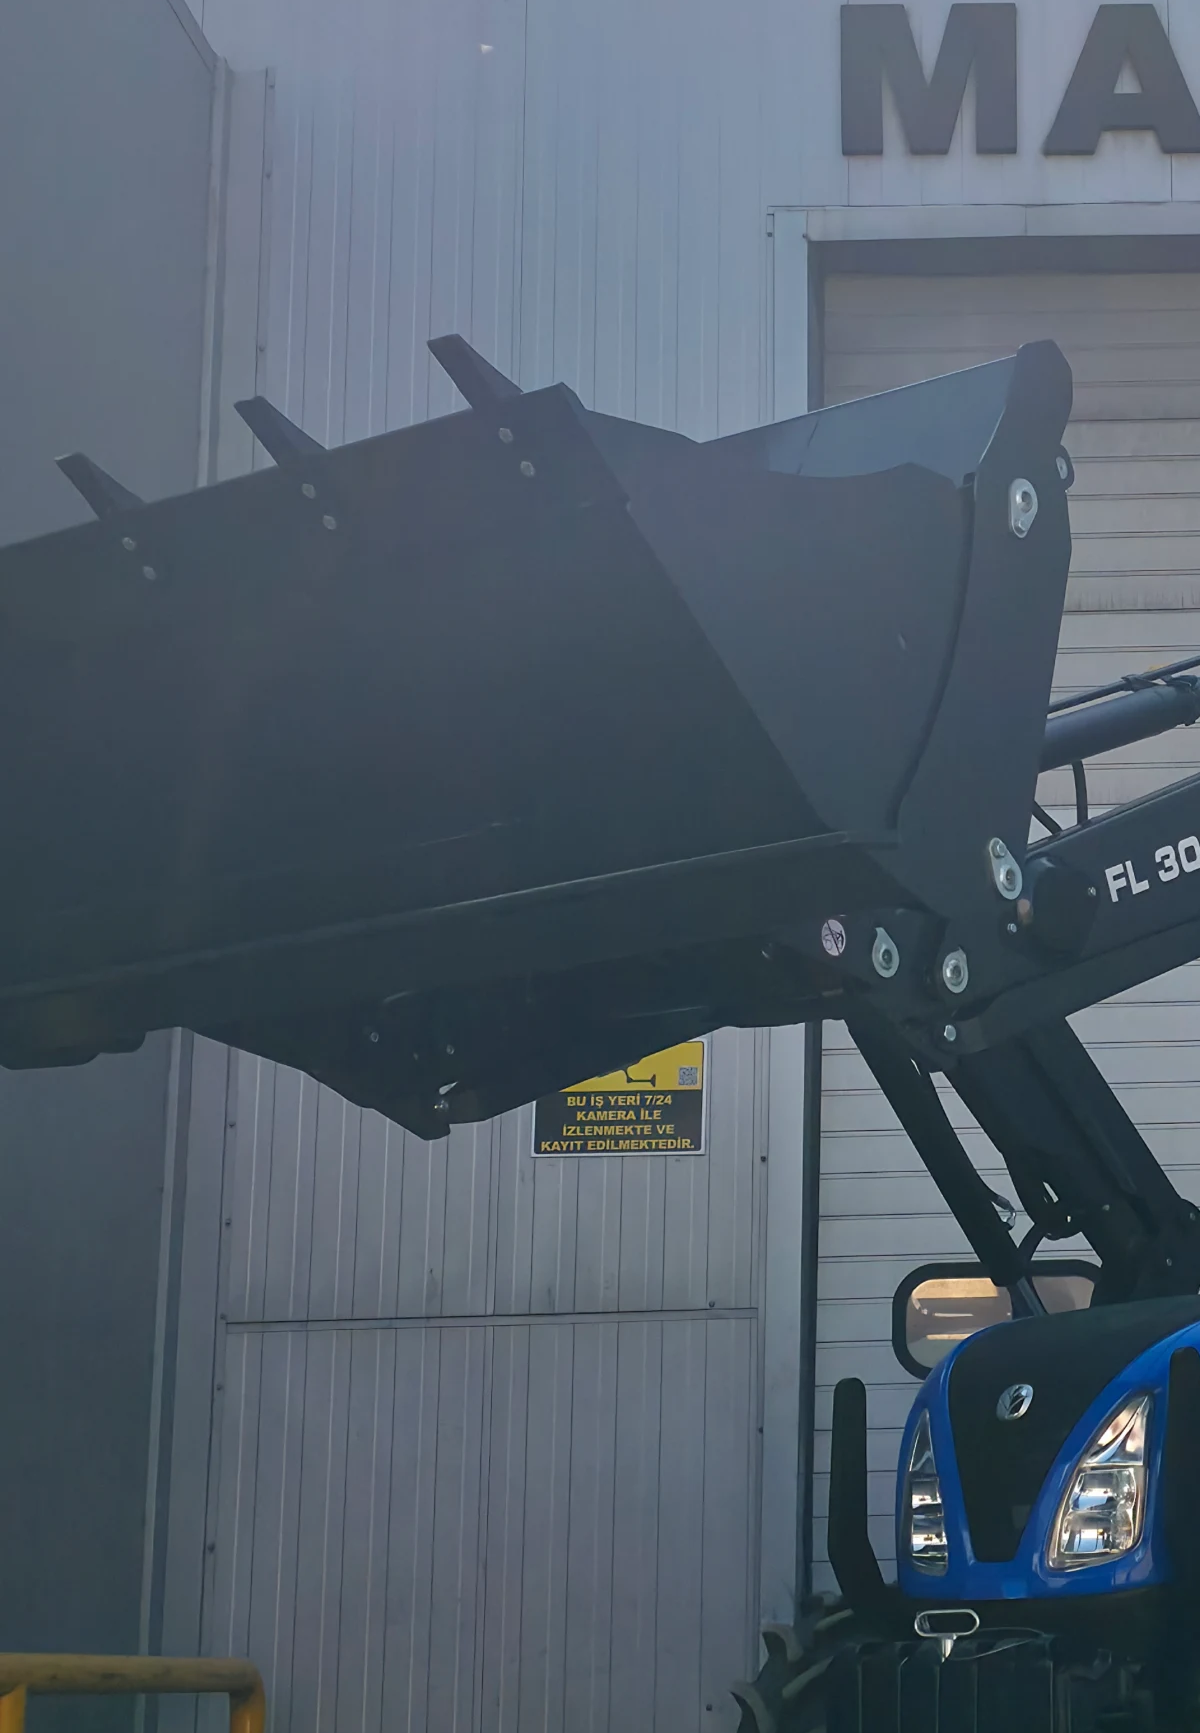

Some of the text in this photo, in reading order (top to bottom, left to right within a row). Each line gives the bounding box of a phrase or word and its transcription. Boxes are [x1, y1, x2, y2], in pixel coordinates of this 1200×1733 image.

[1104, 860, 1150, 903] FL
[566, 1093, 673, 1109] BU İŞ YERİ 7/24
[576, 1108, 662, 1122] KAMERA İLE
[562, 1123, 675, 1137] İZLENMEKTE VE
[540, 1136, 695, 1152] KAYIT EDİLMEKTEDİR.
